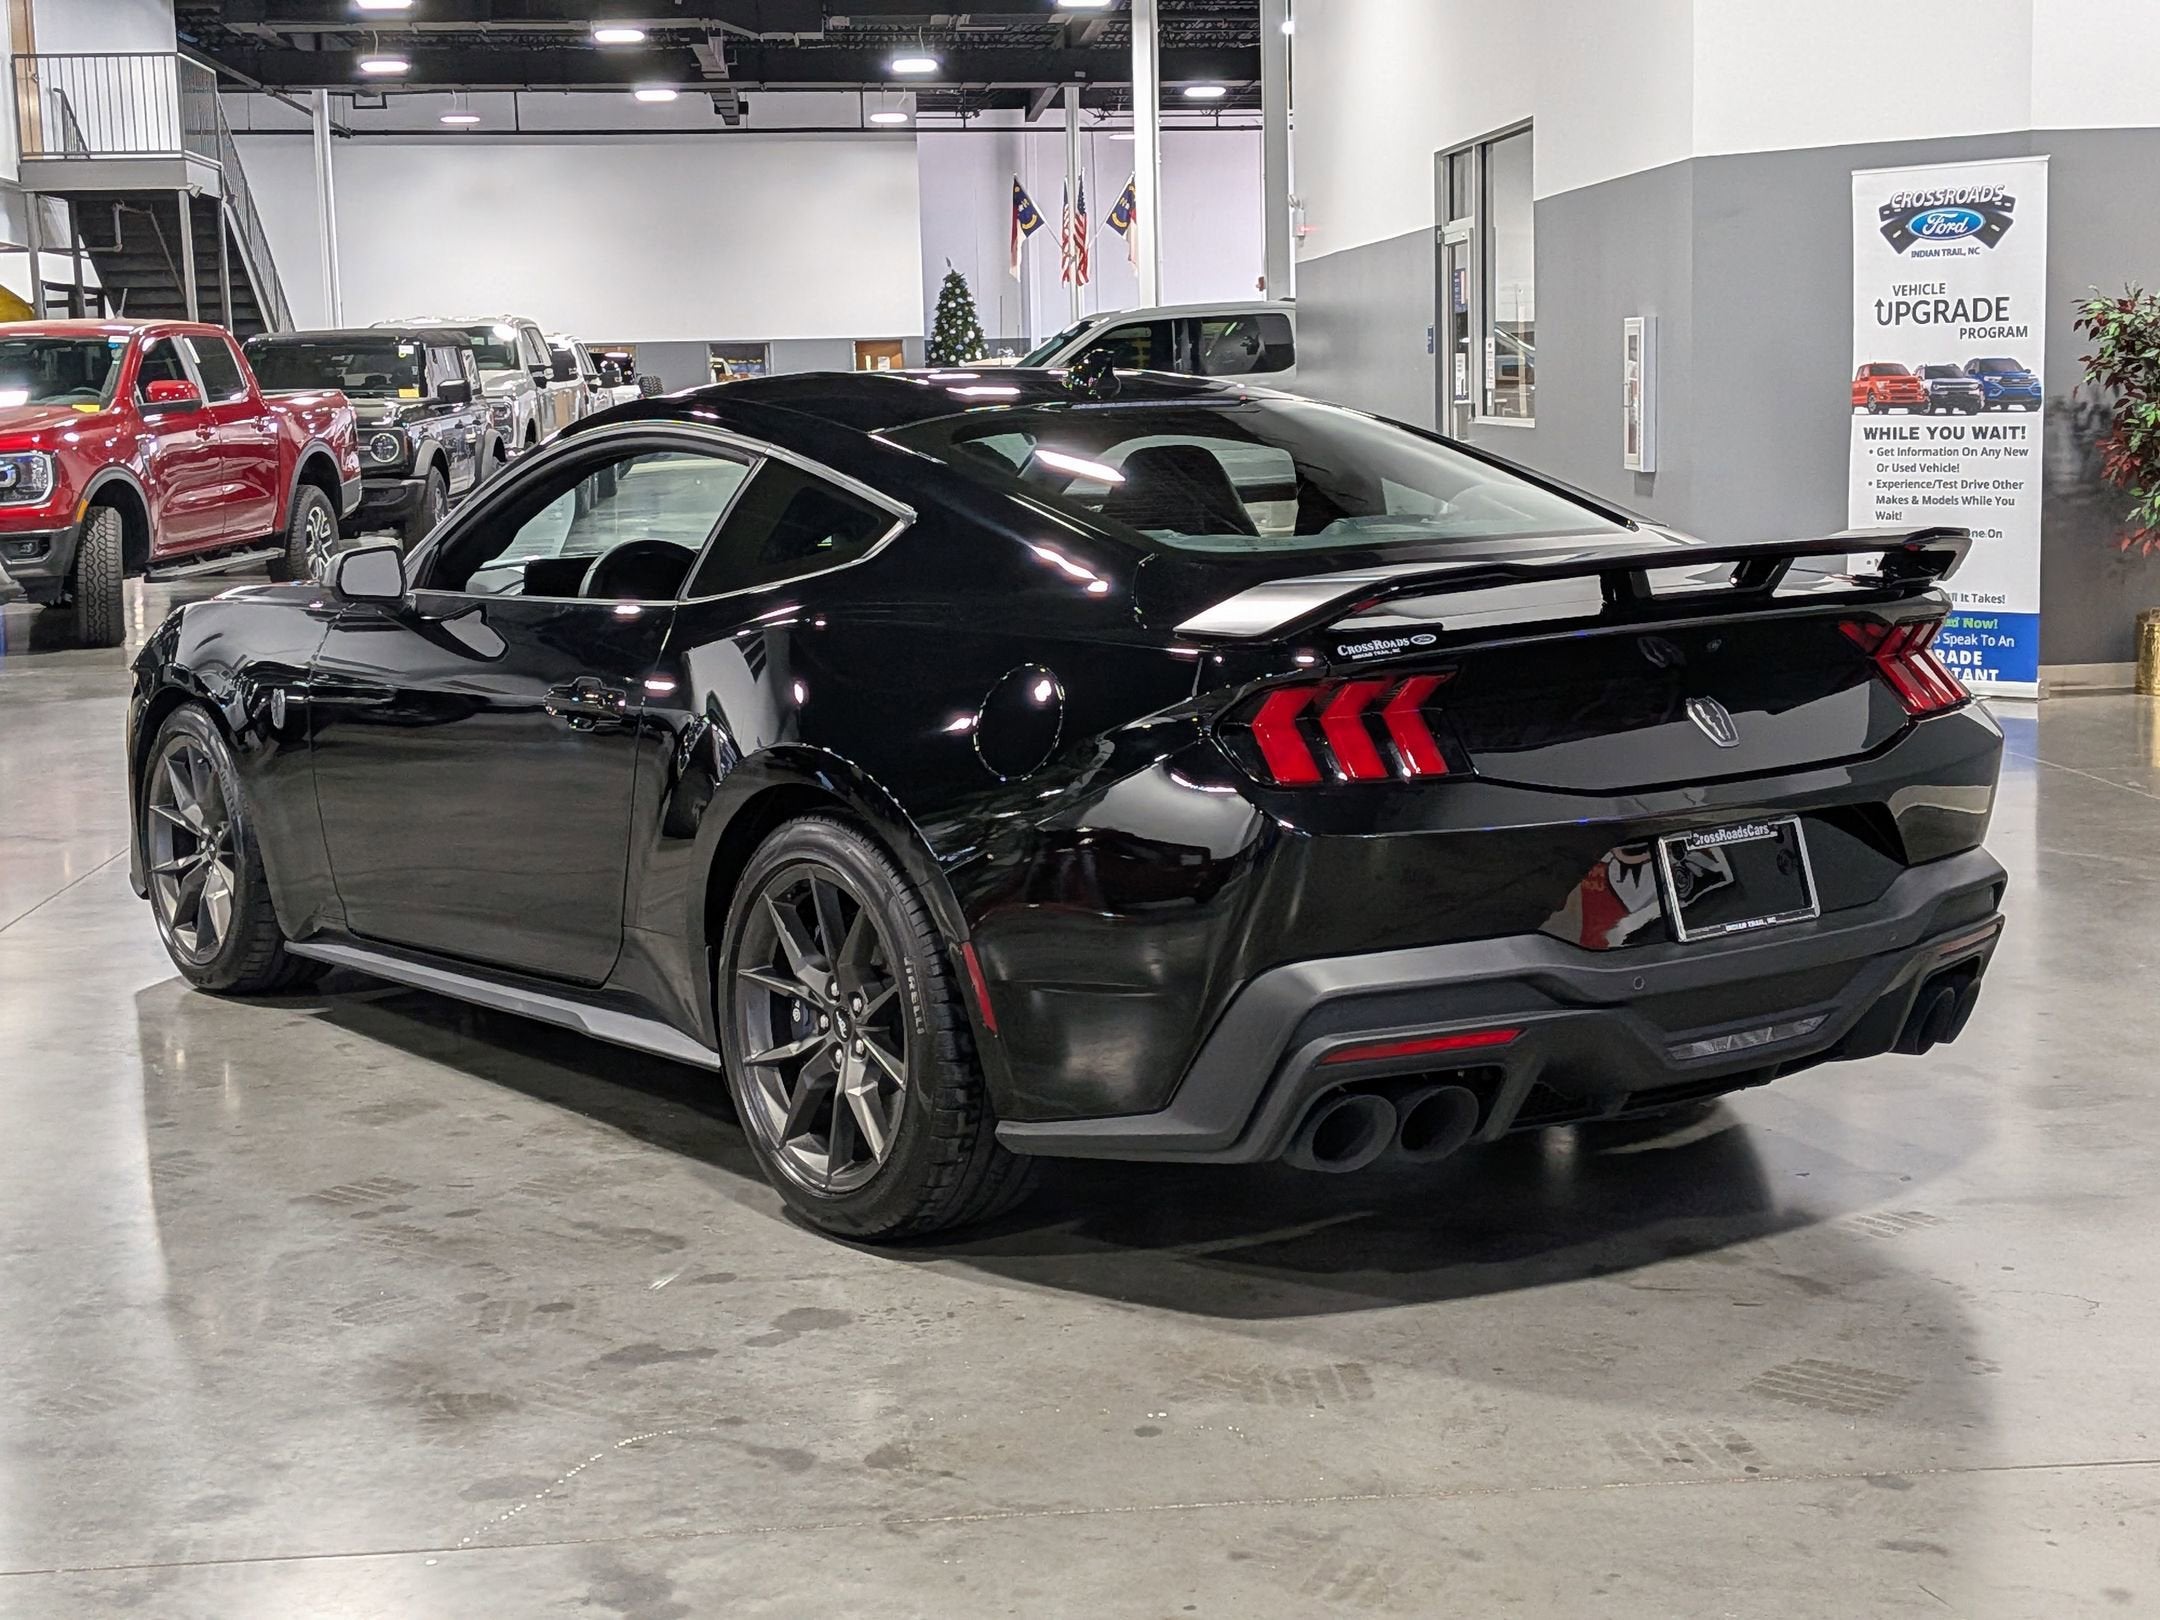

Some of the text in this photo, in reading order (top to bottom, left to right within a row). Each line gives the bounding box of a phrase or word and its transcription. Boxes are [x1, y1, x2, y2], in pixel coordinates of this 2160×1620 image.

[1890, 184, 2006, 209] CROSSROADS
[1921, 212, 1970, 236] Ford
[1911, 246, 1981, 258] INDIAN TRAIL, NC
[1892, 282, 1947, 297] VEHICLE
[1874, 296, 2011, 326] UPGRADE
[1959, 325, 2029, 340] PROGRAM
[1863, 425, 2026, 441] WHILE YOU WAIT!
[1876, 446, 2029, 460] Get Information On Any New
[1876, 462, 1960, 473] Or Used Vehicle!
[1876, 479, 2024, 491] Experience/Test Drive Other
[1876, 495, 2015, 506] Makes & Models While You
[1875, 510, 1902, 521] Wait!
[1987, 528, 2003, 539] On
[1960, 593, 1970, 603] It
[1971, 593, 2006, 604] Takes!
[1962, 617, 1999, 630] Now!
[1942, 632, 1978, 648] Speak
[1980, 634, 1996, 647] To
[1997, 634, 2015, 648] An
[1934, 649, 1983, 666] RADE
